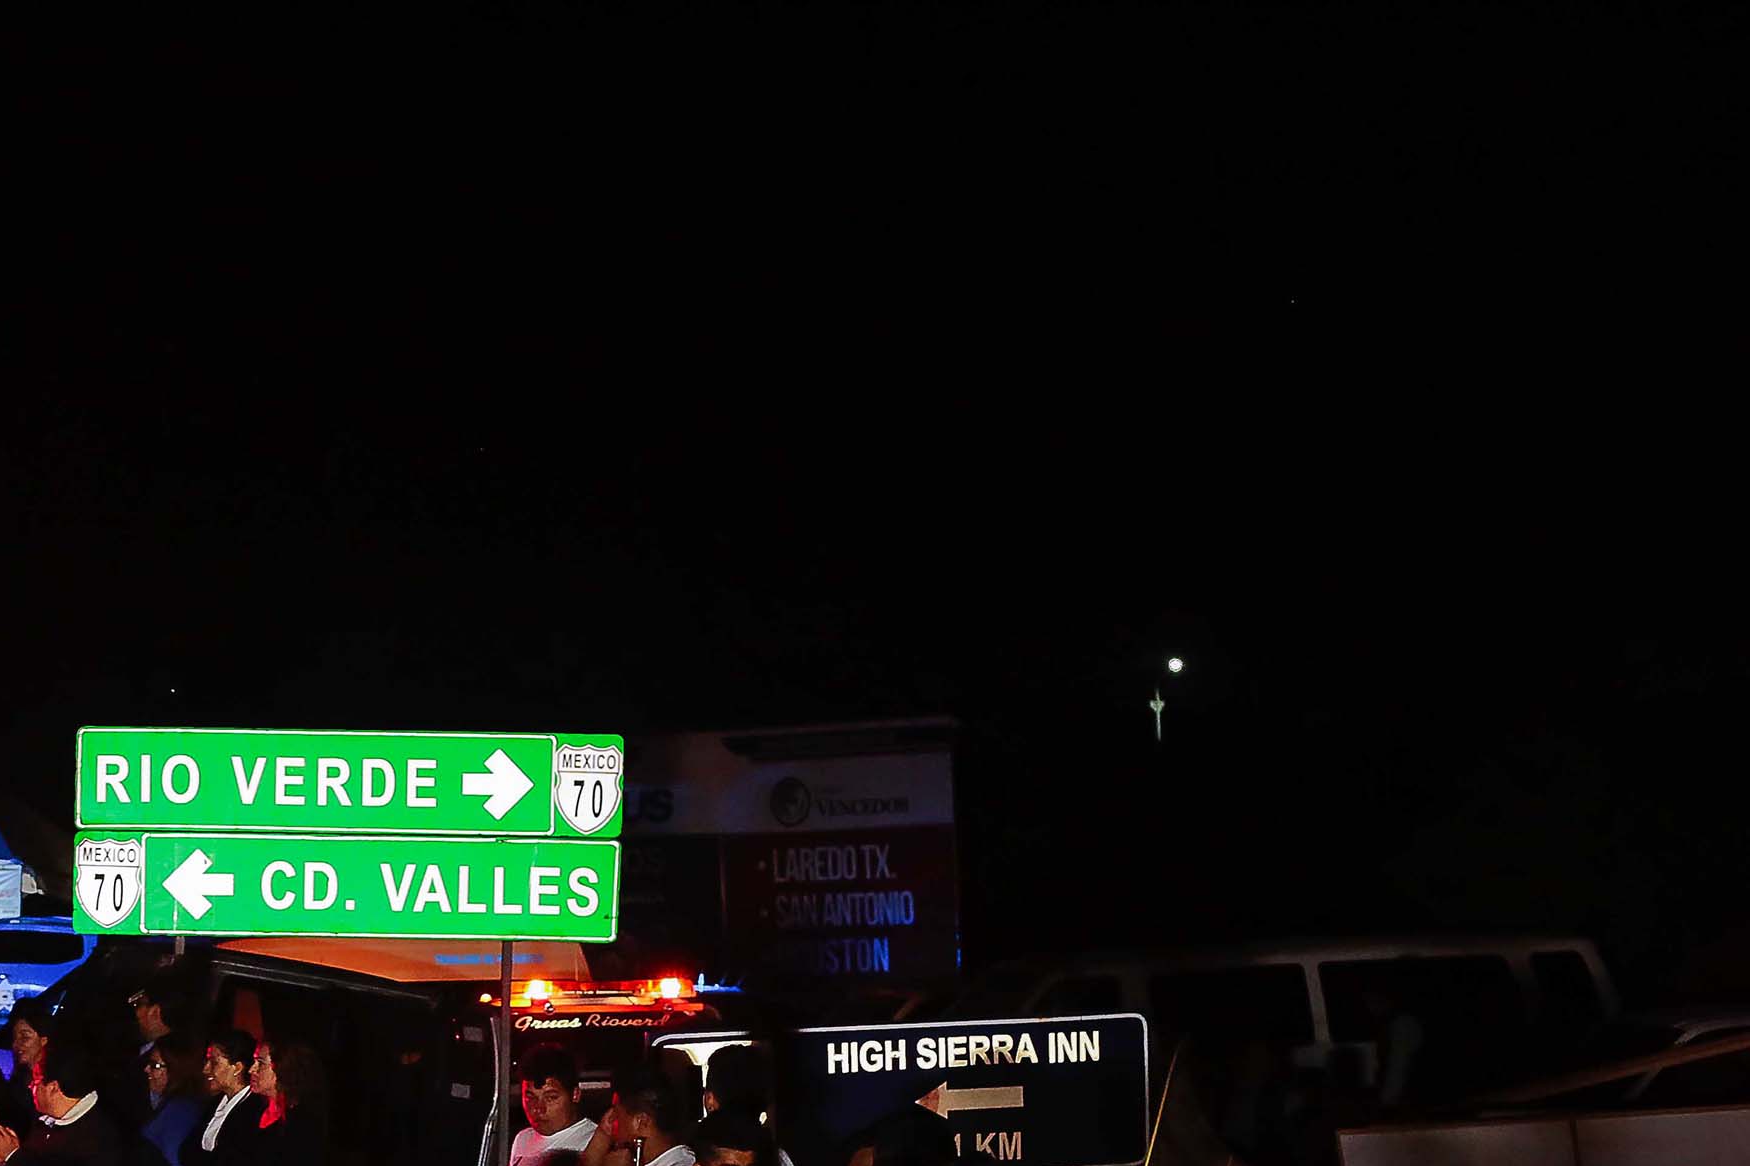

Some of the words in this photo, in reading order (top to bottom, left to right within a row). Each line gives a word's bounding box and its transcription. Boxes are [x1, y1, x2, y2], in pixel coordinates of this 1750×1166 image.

[95, 754, 201, 805] RIO
[231, 756, 438, 808] VERDE
[562, 752, 617, 772] MEXICO
[572, 779, 604, 818] 70
[82, 847, 137, 864] MEXICO
[772, 845, 857, 882] LAREDO
[859, 843, 898, 880] TX.
[93, 873, 125, 912] 70
[260, 860, 356, 911] CD.
[380, 863, 600, 917] VALLES
[775, 893, 820, 927] SAN
[824, 890, 915, 927] ANTONIO
[827, 1039, 906, 1074] HIGH
[916, 1032, 1038, 1070] SIERRA
[1048, 1030, 1100, 1064] INN
[975, 1131, 1022, 1161] KM
